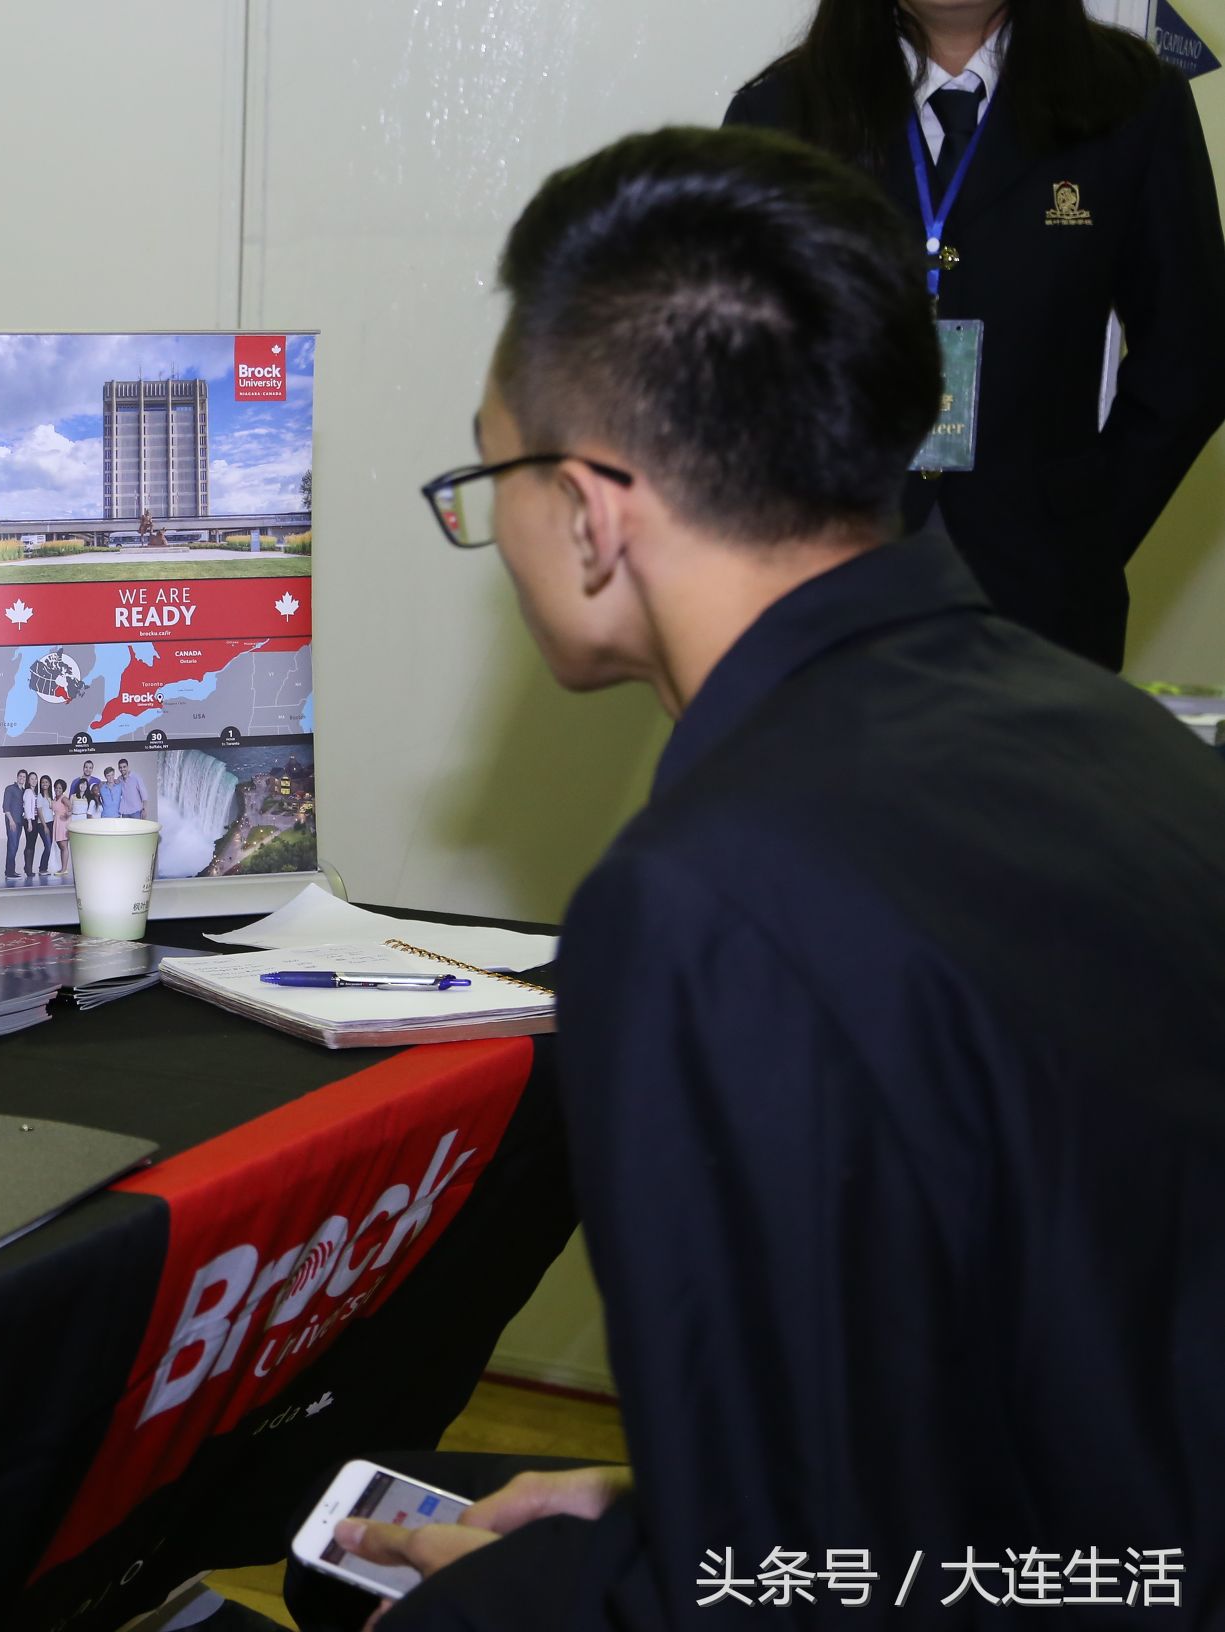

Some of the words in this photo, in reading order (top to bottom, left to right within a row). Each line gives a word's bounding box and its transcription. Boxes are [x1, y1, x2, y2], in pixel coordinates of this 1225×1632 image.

[238, 364, 281, 378] Brock
[239, 378, 282, 390] University
[118, 588, 148, 605] WE
[155, 587, 191, 604] ARE
[115, 605, 197, 628] READY
[122, 692, 154, 703] Brock
[76, 736, 88, 744] 20
[151, 733, 162, 741] 30
[228, 730, 233, 738] 1
[135, 1129, 477, 1430] Brock
